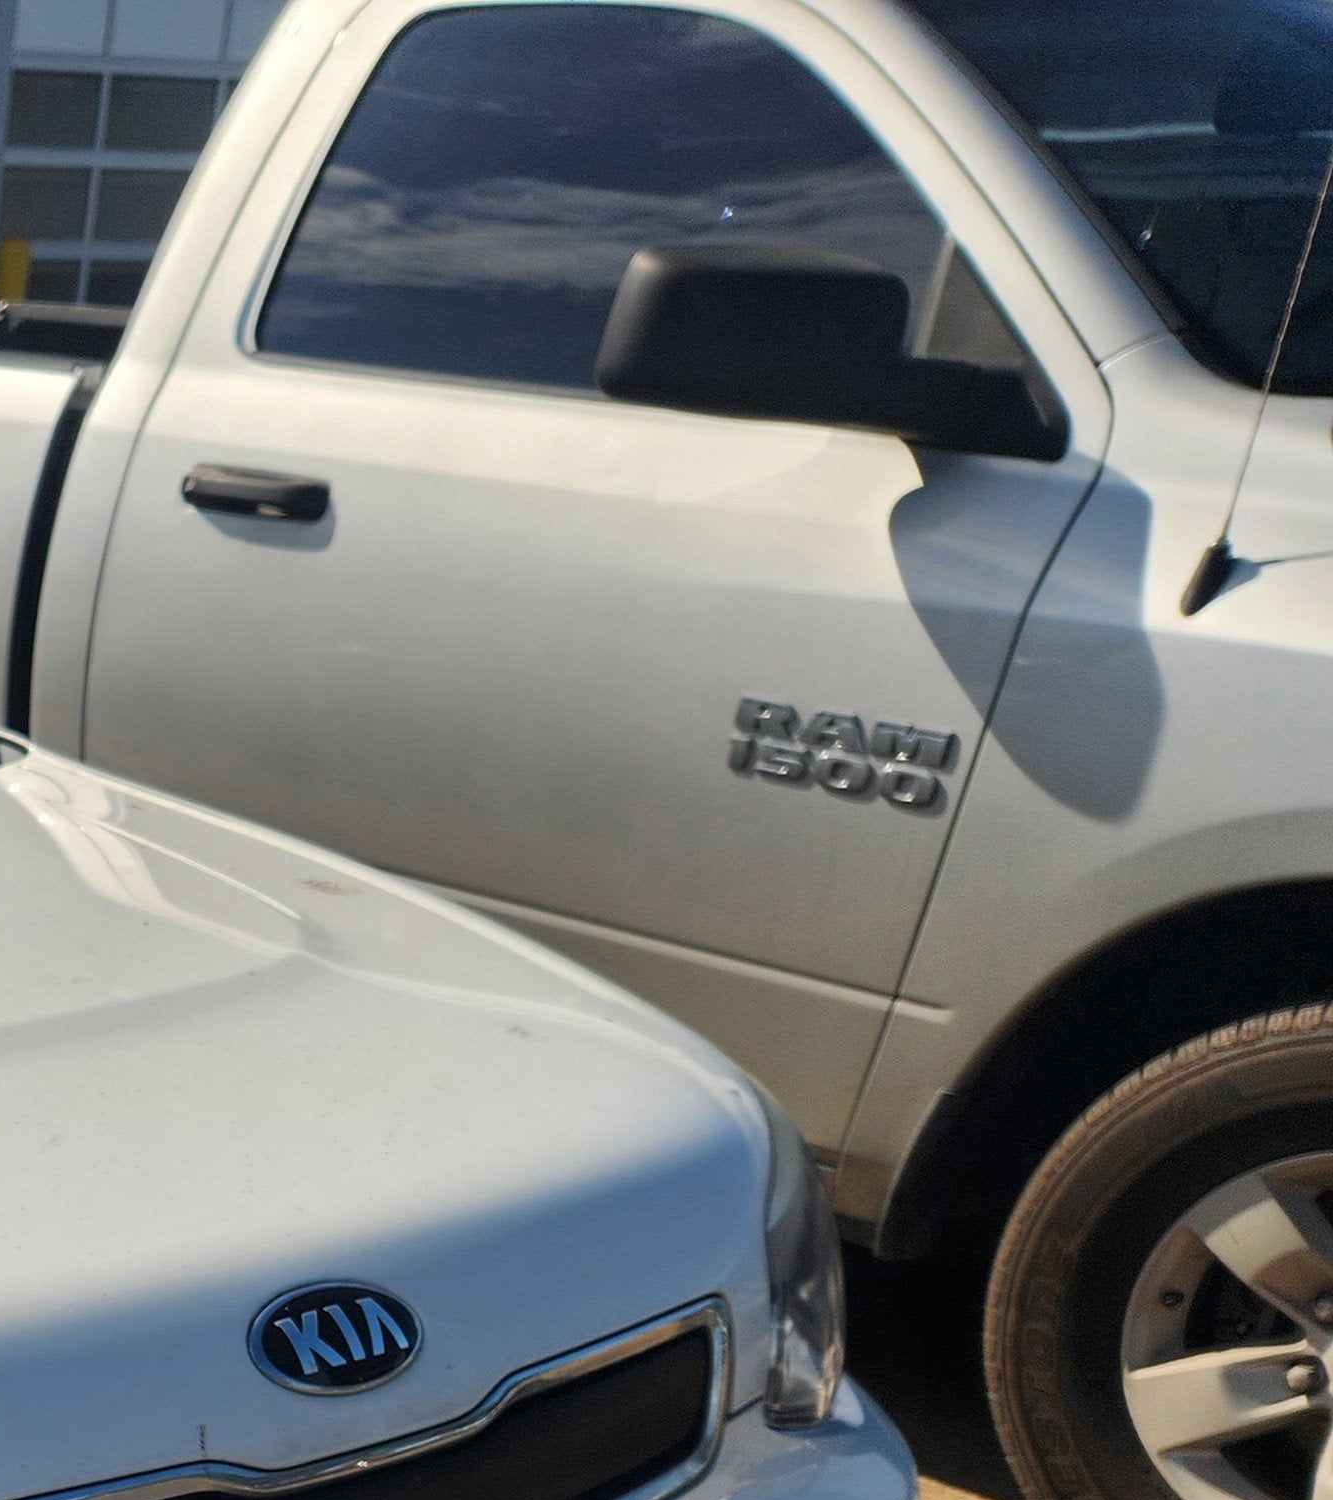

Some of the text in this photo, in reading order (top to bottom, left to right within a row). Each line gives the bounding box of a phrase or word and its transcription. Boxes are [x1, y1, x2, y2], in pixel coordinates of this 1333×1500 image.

[735, 698, 961, 775] RAM
[728, 738, 948, 818] 1500
[274, 1298, 409, 1375] KIA
